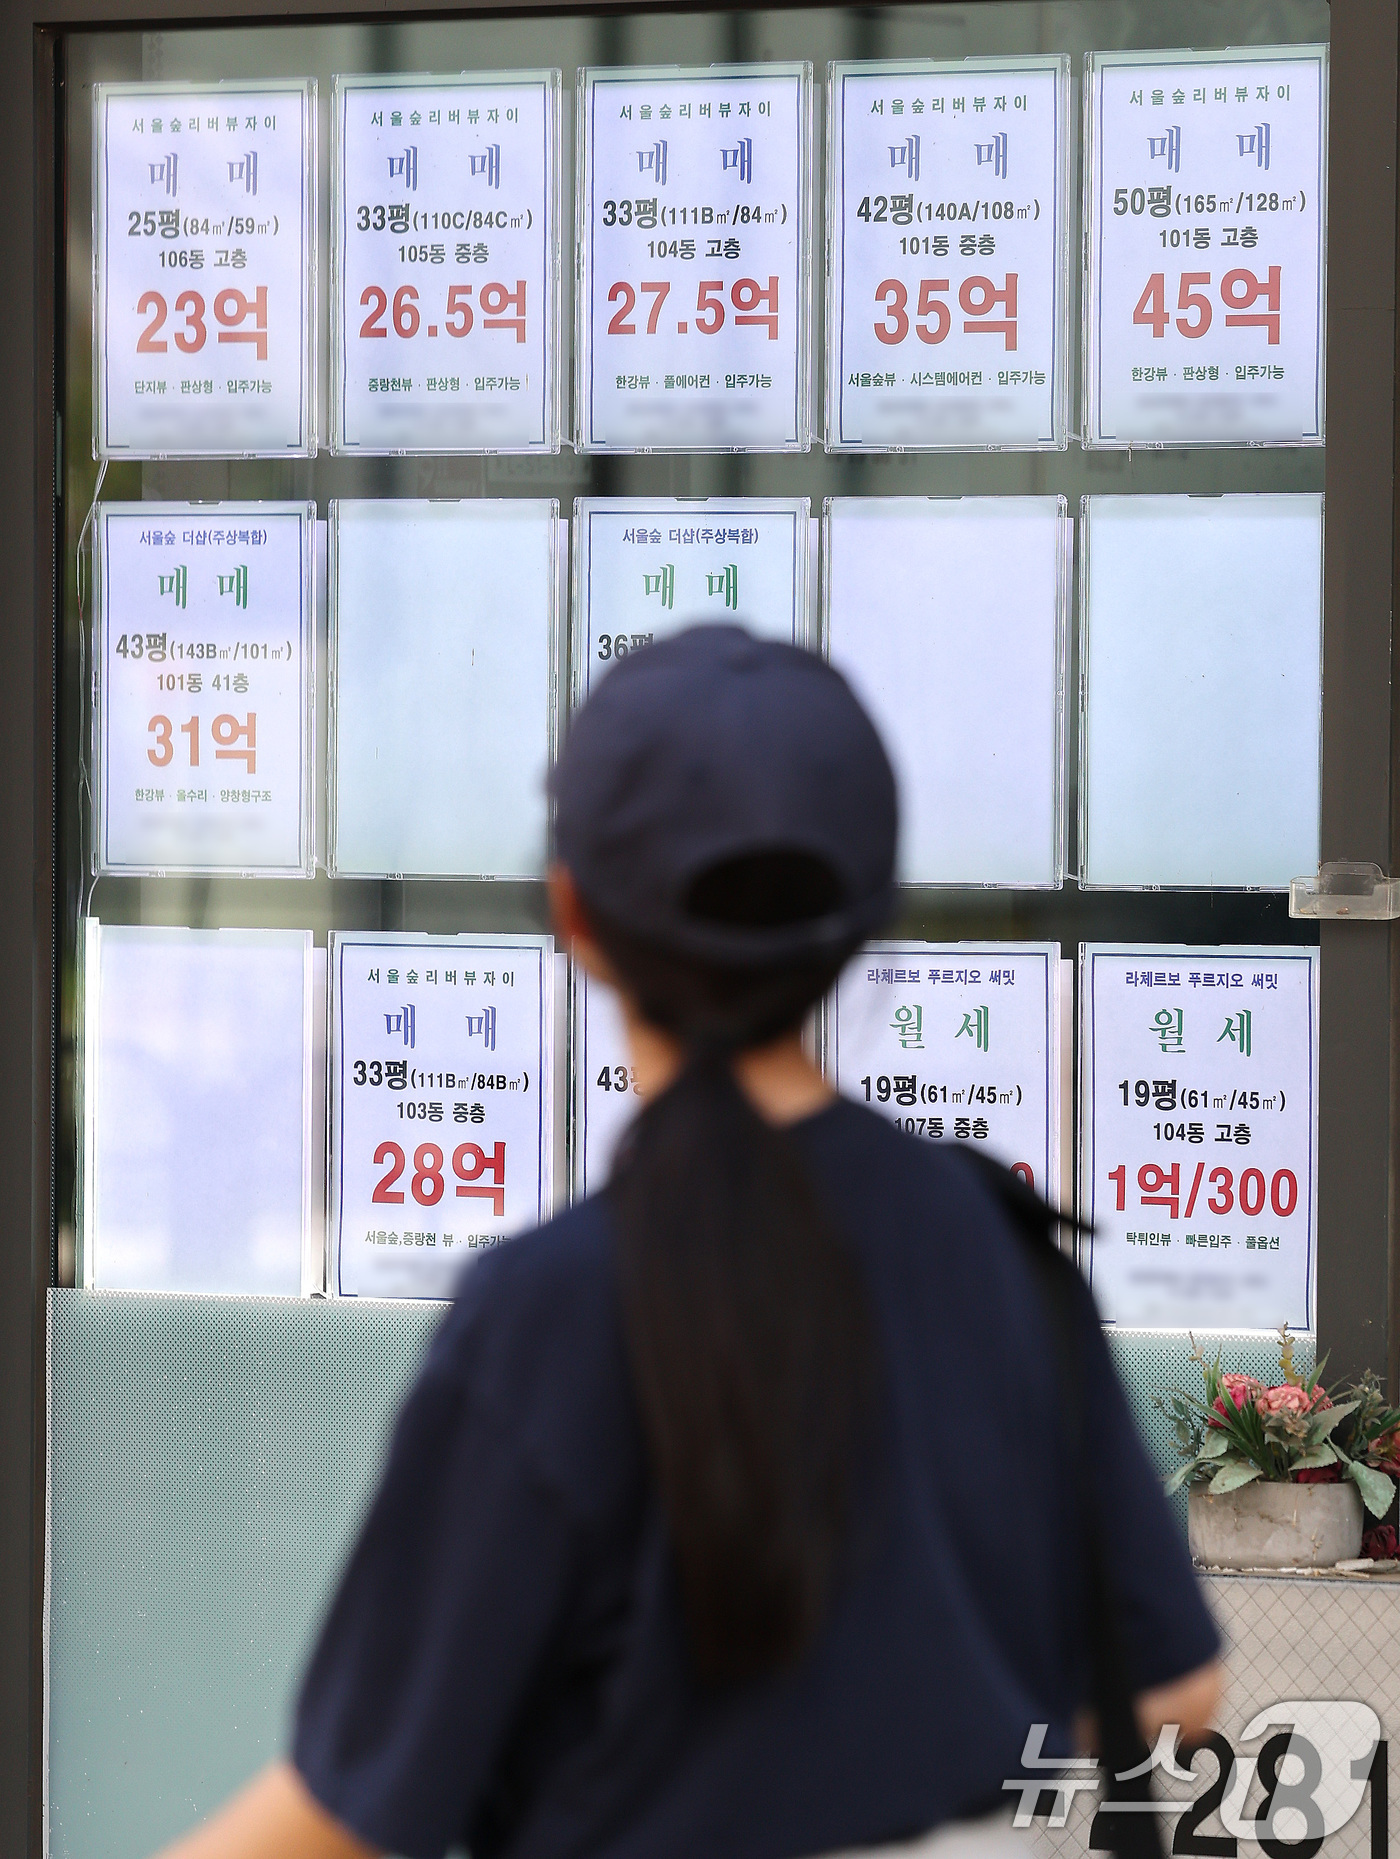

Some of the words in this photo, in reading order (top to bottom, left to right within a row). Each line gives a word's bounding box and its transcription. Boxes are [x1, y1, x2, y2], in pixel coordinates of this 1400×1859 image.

[870, 95, 1028, 116] 서울숲리버뷰자이
[1129, 85, 1291, 106] 서울숲리버뷰자이
[370, 107, 519, 126] 서울숲리버뷰자이
[619, 100, 772, 120] 서울숲리버뷰자이
[132, 116, 277, 133] 서울숲리버뷰자이
[899, 235, 950, 256] 101동
[958, 234, 996, 255] 중층
[1159, 228, 1212, 249] 101동
[1220, 227, 1259, 248] 고층
[158, 249, 205, 269] 106동
[213, 248, 248, 269] 고층
[398, 244, 446, 265] 105동
[454, 243, 490, 264] 중층
[647, 239, 697, 260] 104동
[705, 238, 741, 259] 고층
[358, 280, 527, 344] 26.5억
[607, 275, 780, 341] 27.5억
[873, 272, 1019, 352] 35억
[1132, 265, 1282, 345] 45억
[136, 285, 269, 361] 23억
[615, 374, 651, 390] 한강뷰
[663, 374, 711, 389] 풀에어컨
[724, 373, 773, 389] 입주가능
[847, 371, 897, 388] 서울숲뷰
[910, 371, 983, 387] 시스템에어컨
[997, 369, 1046, 386] 입주가능
[1131, 366, 1169, 382] 한강뷰
[1182, 365, 1220, 382] 판상형
[1234, 364, 1285, 381] 입주가능
[134, 379, 167, 394] 단지뷰
[180, 379, 214, 394] 판상형
[226, 378, 273, 394] 입주가능
[367, 378, 413, 393] 중랑천뷰
[426, 378, 461, 392] 판상형
[474, 376, 521, 392] 입주가능
[139, 528, 177, 546] 서울숲
[182, 527, 268, 546] 더샵(주상복합)
[622, 527, 662, 545] 서울숲
[668, 526, 760, 546] 더샵(주상복합)
[156, 673, 203, 693] 101동
[212, 672, 250, 693] 41층
[147, 712, 257, 774] 31억
[134, 788, 165, 802] 한강뷰
[367, 968, 515, 987] 서울숲리버뷰자이
[867, 968, 921, 985] 라체르보
[927, 969, 982, 986] 푸르지오
[988, 969, 1016, 986] 써밋
[1125, 971, 1182, 988] 라체르보
[1187, 972, 1244, 989] 푸르지오
[1251, 972, 1278, 990] 써밋
[396, 1102, 444, 1123] 103동
[452, 1102, 486, 1124] 중층
[953, 1117, 990, 1139] 중층
[1153, 1122, 1205, 1144] 104동
[1214, 1123, 1252, 1145] 고층
[371, 1141, 507, 1217] 28억
[1108, 1162, 1299, 1219] 1억/300
[1185, 1233, 1232, 1249] 빠른입주
[1245, 1235, 1280, 1250] 풀옵션
